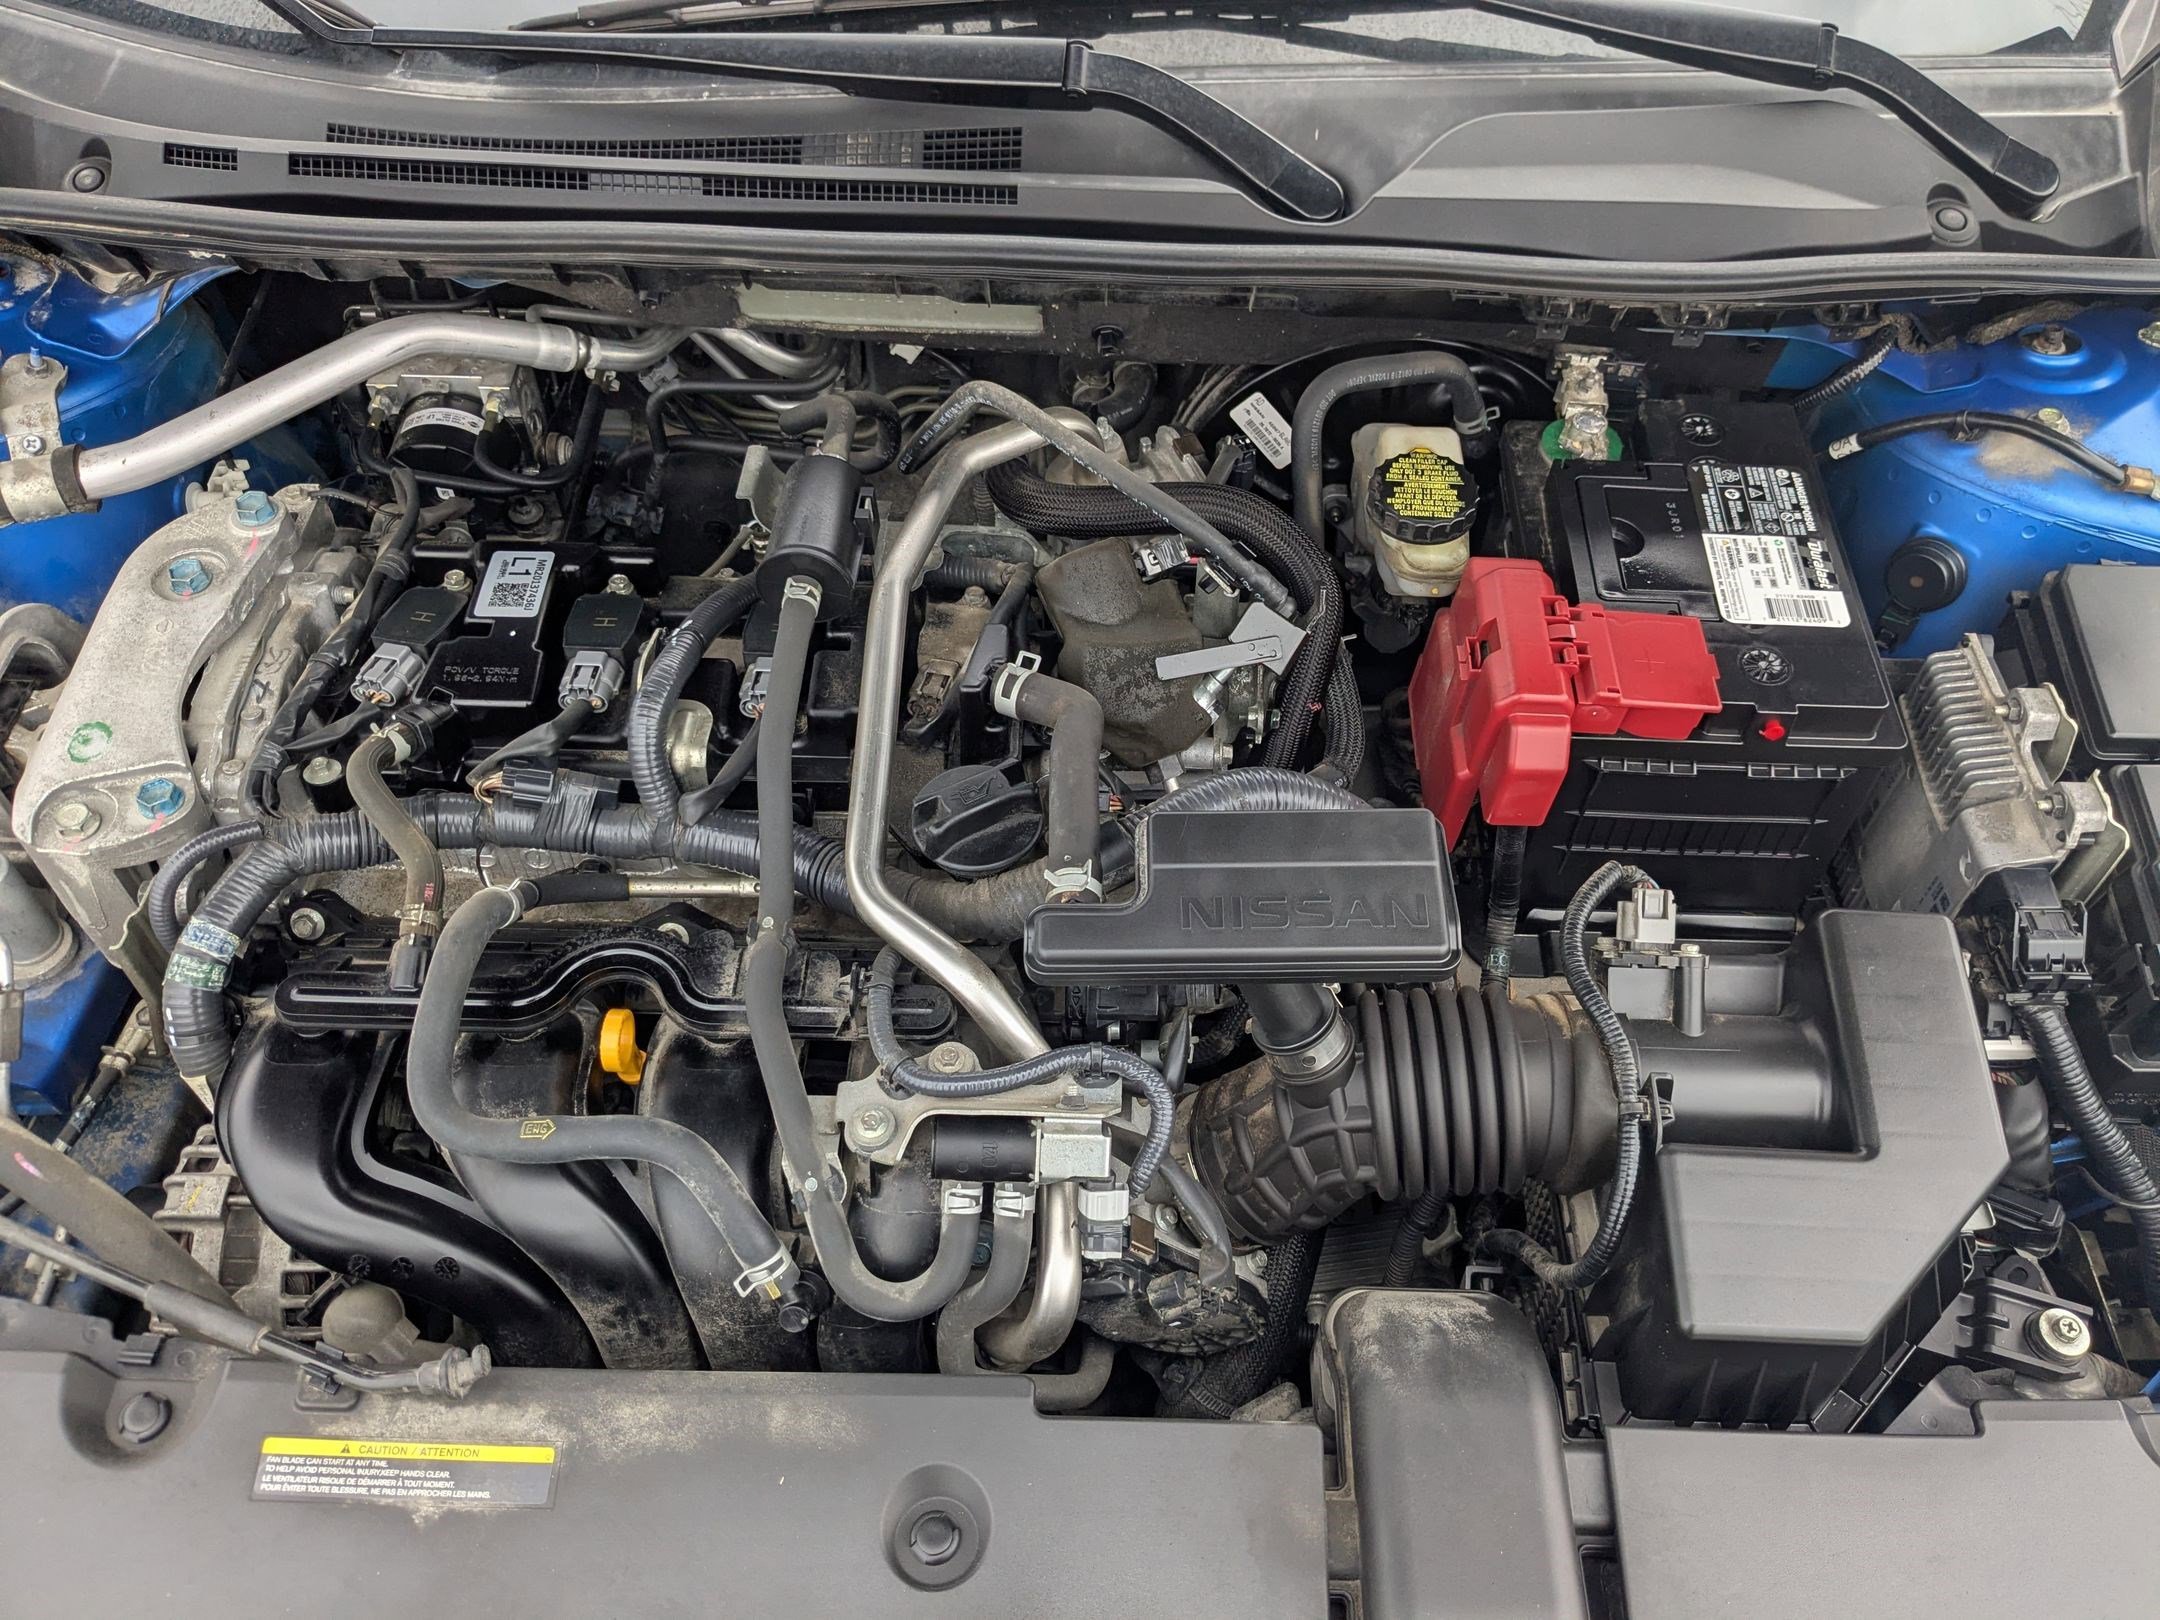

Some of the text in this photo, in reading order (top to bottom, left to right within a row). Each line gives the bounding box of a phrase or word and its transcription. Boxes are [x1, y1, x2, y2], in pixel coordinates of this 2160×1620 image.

[508, 557, 537, 576] L1
[1806, 540, 1835, 590] Duralast
[525, 559, 548, 611] MR20137436J
[1181, 894, 1430, 930] NISSAN
[525, 1123, 549, 1135] ENG
[358, 1445, 408, 1456] CAUTION
[420, 1447, 481, 1458] ATTENTION
[282, 1456, 305, 1464] BLADE
[306, 1457, 322, 1465] CAN
[322, 1458, 344, 1466] START
[265, 1464, 275, 1472] TO
[275, 1464, 295, 1473] HELP
[295, 1465, 318, 1474] AVOID
[318, 1466, 357, 1475] PERSONAL
[400, 1470, 425, 1478] HANDS
[426, 1471, 451, 1479] CLEAR.
[262, 1474, 273, 1482] LE
[273, 1475, 318, 1484] VENTILATEUR
[318, 1477, 345, 1486] RISQUE
[346, 1478, 357, 1486] DE
[403, 1480, 423, 1488] TOUT
[423, 1481, 455, 1489] MOMENT.
[260, 1483, 281, 1491] POUR
[307, 1485, 330, 1493] TOUTE
[371, 1487, 381, 1495] NE
[381, 1488, 397, 1496] PAS
[407, 1489, 452, 1498] APPROCHER
[452, 1490, 467, 1498] LES
[467, 1491, 491, 1499] MAINS.
